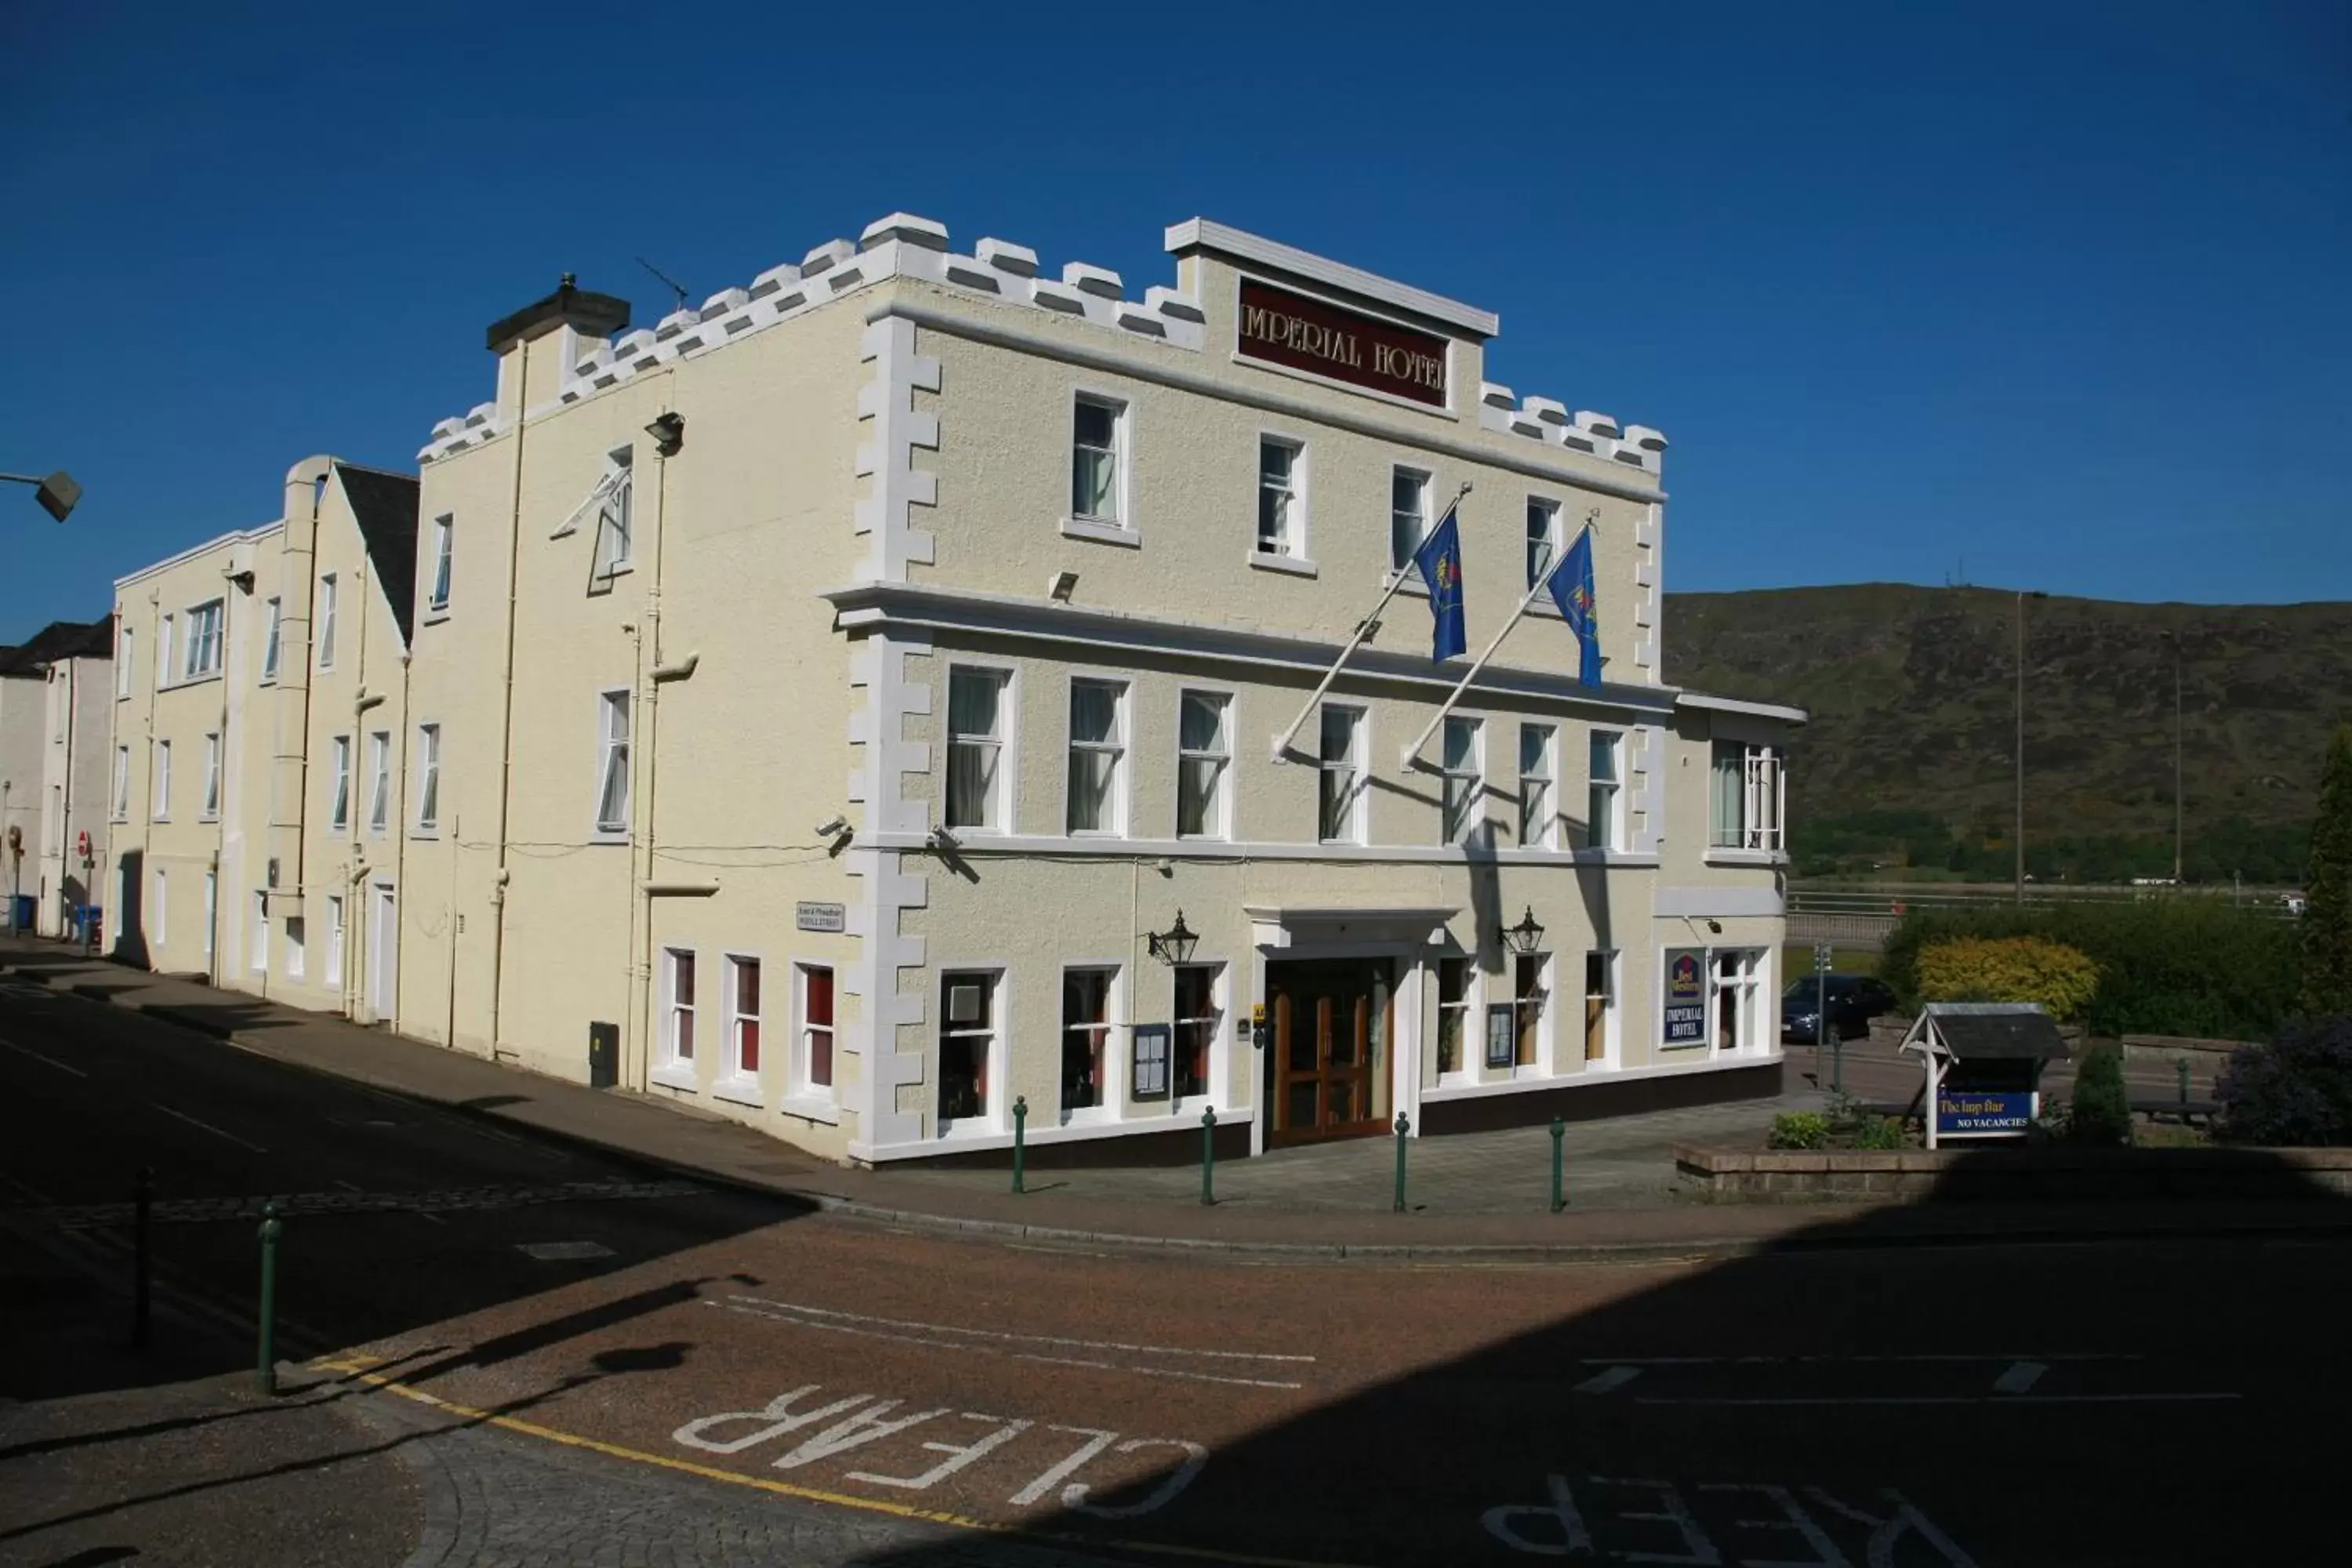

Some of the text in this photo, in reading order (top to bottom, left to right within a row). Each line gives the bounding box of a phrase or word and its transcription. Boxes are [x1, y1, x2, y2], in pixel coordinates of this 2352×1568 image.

[1373, 342, 1446, 390] HOTEL
[1671, 1022, 1697, 1037] HOTEL
[1940, 1099, 1960, 1114] The
[1957, 1116, 2028, 1128] NO VACANCIES
[672, 1383, 1210, 1519] CLEAR
